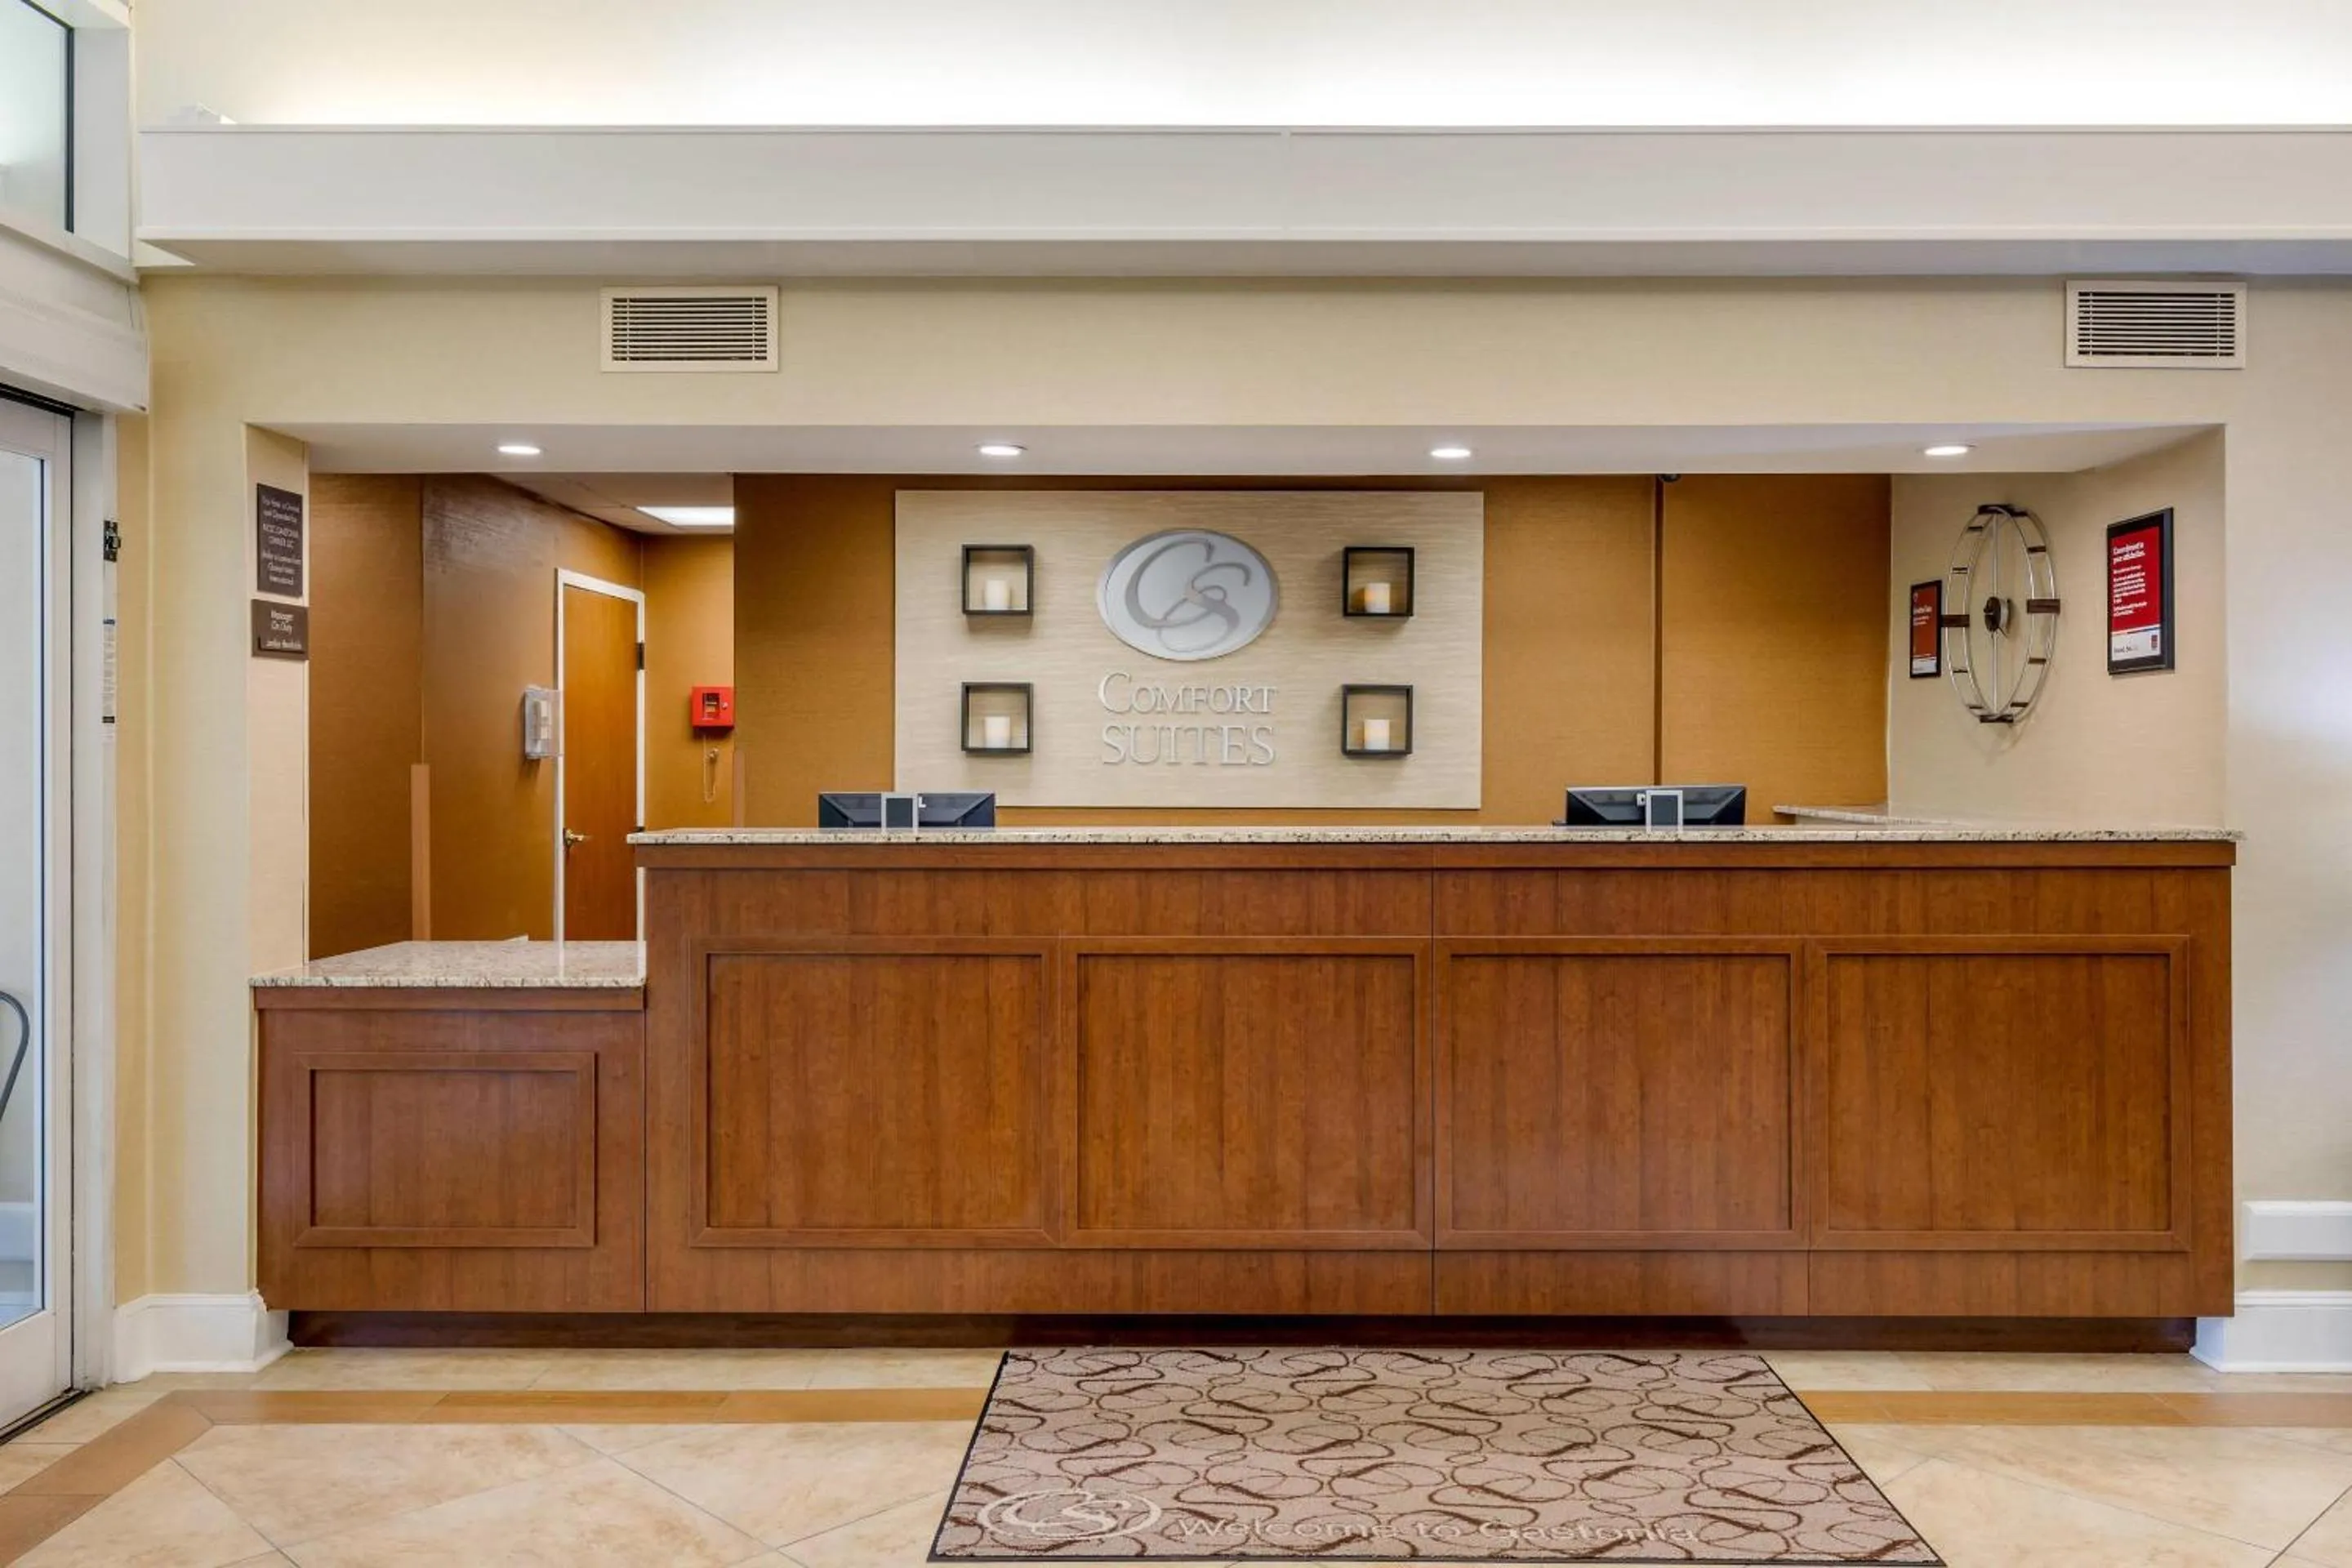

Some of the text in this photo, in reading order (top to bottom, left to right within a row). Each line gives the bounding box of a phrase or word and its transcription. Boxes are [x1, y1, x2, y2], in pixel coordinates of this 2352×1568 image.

[1098, 671, 1277, 715] COMFORT
[1102, 725, 1276, 766] SUITES
[1178, 1517, 1699, 1542] Welcome to Gastonia
